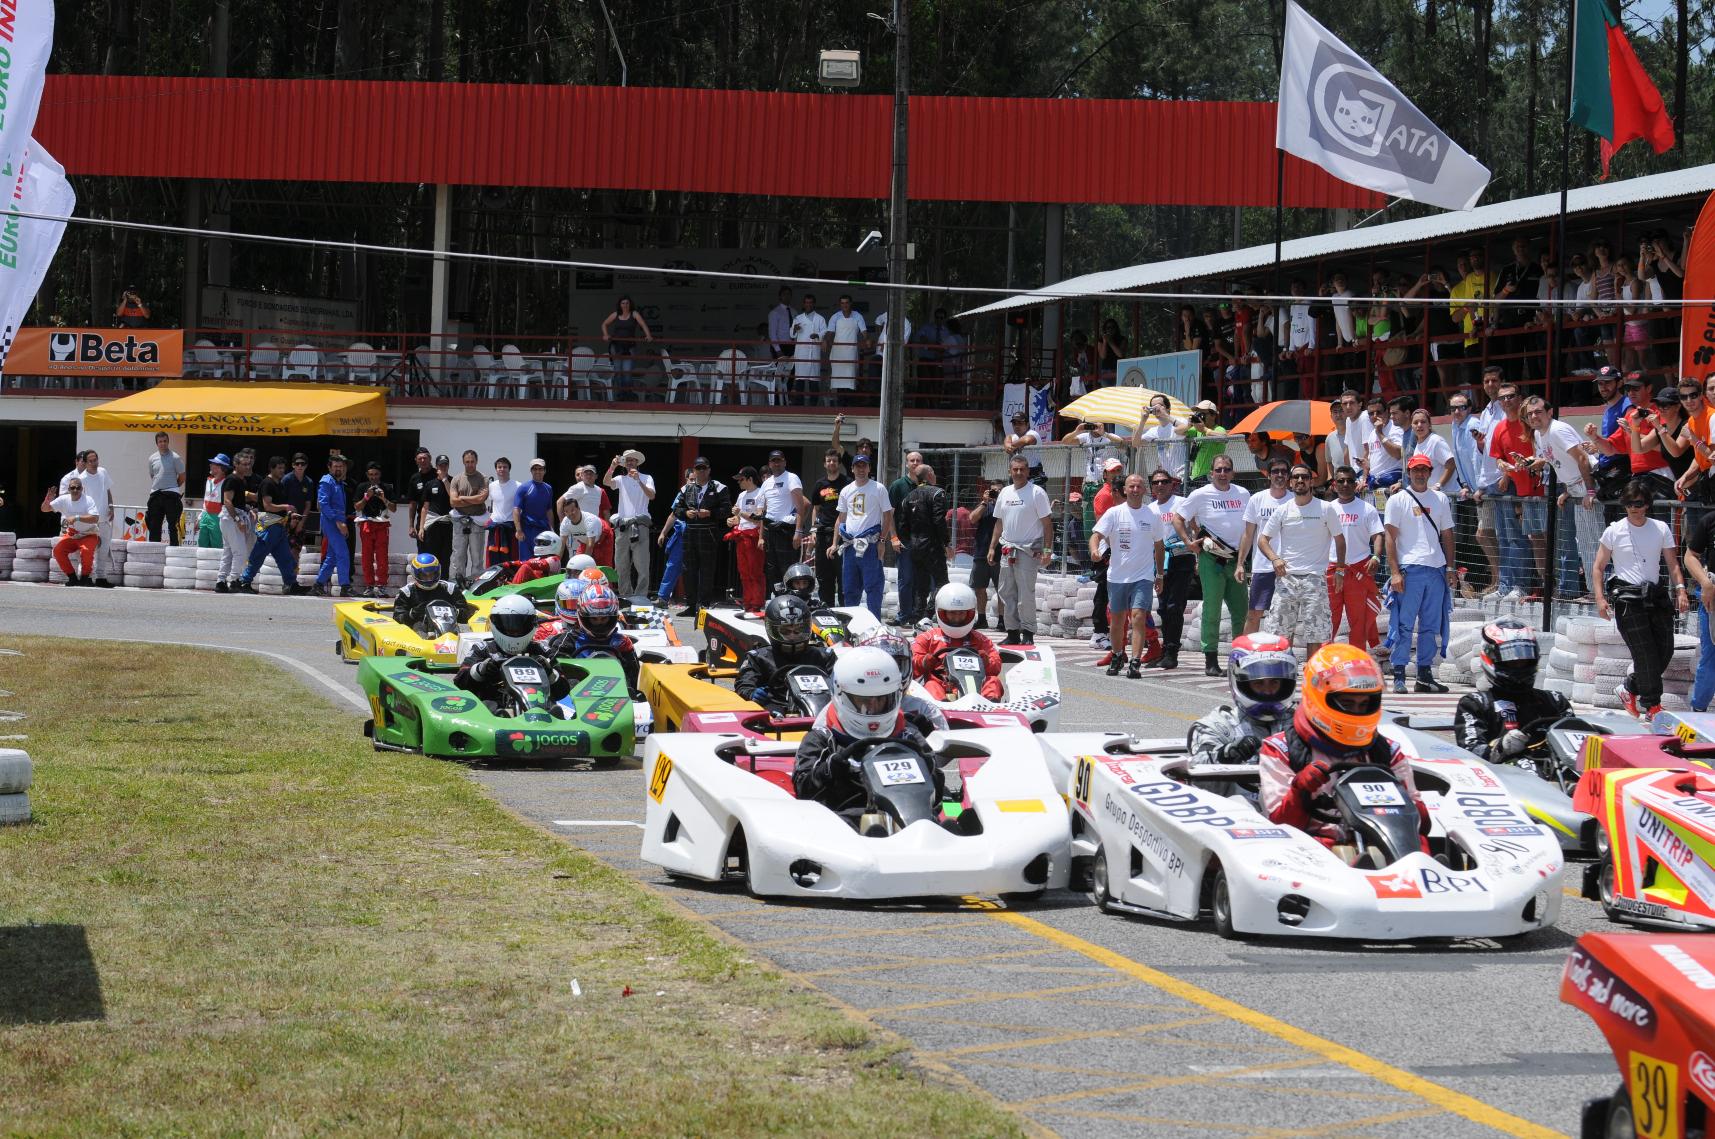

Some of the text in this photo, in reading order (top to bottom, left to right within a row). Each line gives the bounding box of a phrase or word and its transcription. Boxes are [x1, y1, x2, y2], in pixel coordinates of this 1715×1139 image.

[81, 333, 160, 363] Beta
[125, 423, 290, 435] www.pestronix.pt
[1212, 500, 1241, 510] UNITRIP
[514, 668, 536, 676] 89
[536, 734, 578, 750] JOGOS
[883, 761, 912, 772] 129
[1076, 757, 1091, 803] 90
[1362, 784, 1386, 793] 90
[1130, 782, 1236, 827] GDBP
[1105, 793, 1184, 878] Grupo Desportivo BPI
[1639, 807, 1695, 867] UNITRIP
[1419, 868, 1489, 893] BPI
[1610, 993, 1650, 1026] more
[1637, 1061, 1669, 1138] 39
